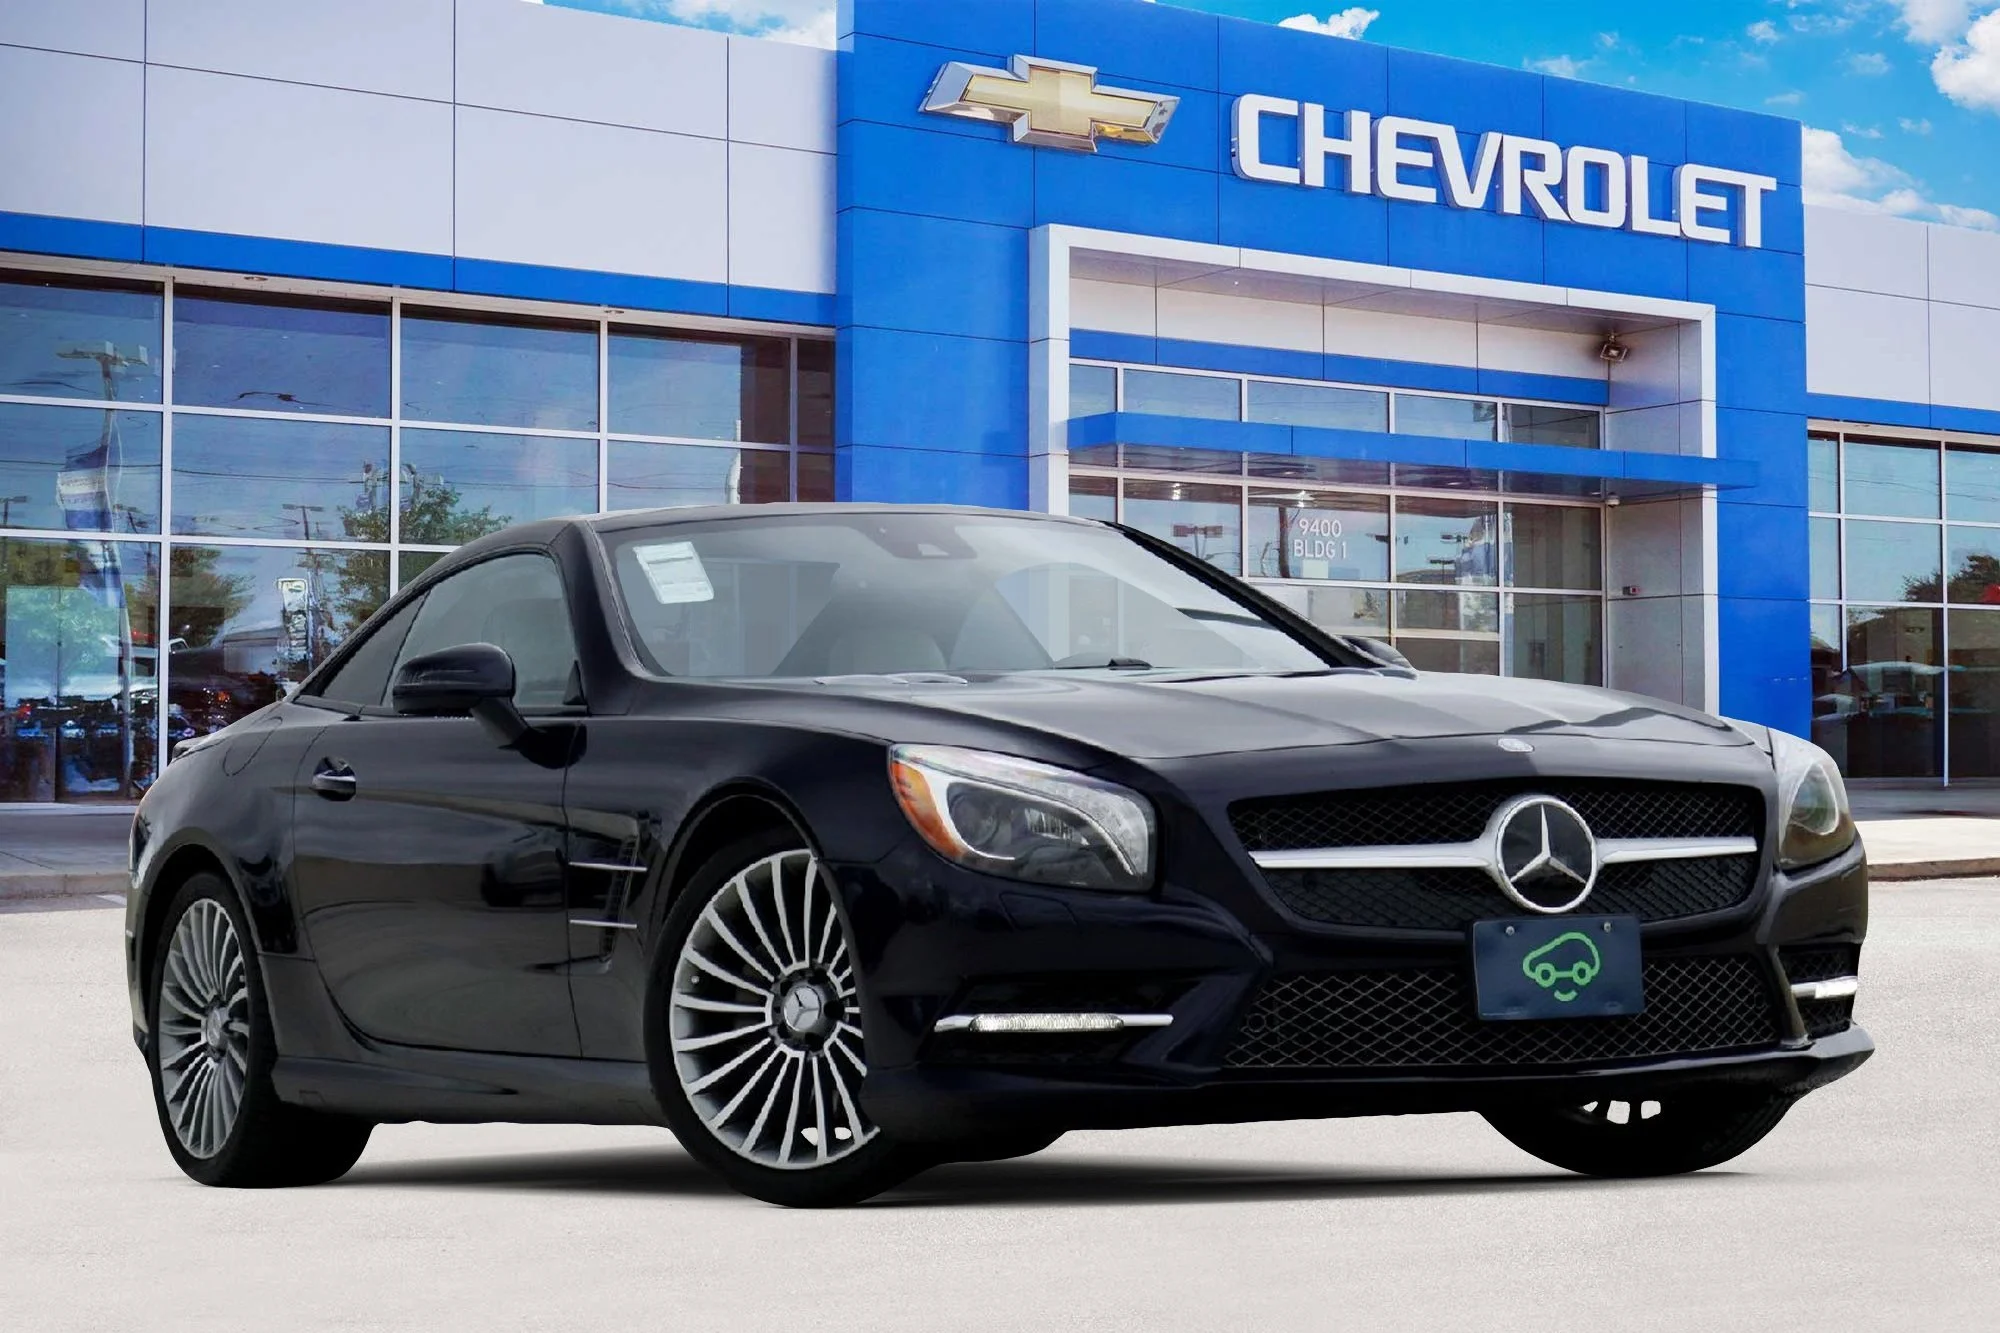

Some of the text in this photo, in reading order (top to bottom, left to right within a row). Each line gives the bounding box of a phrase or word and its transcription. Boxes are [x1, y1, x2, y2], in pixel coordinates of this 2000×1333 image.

[1231, 93, 1777, 248] CHEVROLET
[1299, 519, 1341, 537] 9400
[1294, 539, 1346, 559] BLDG 1
